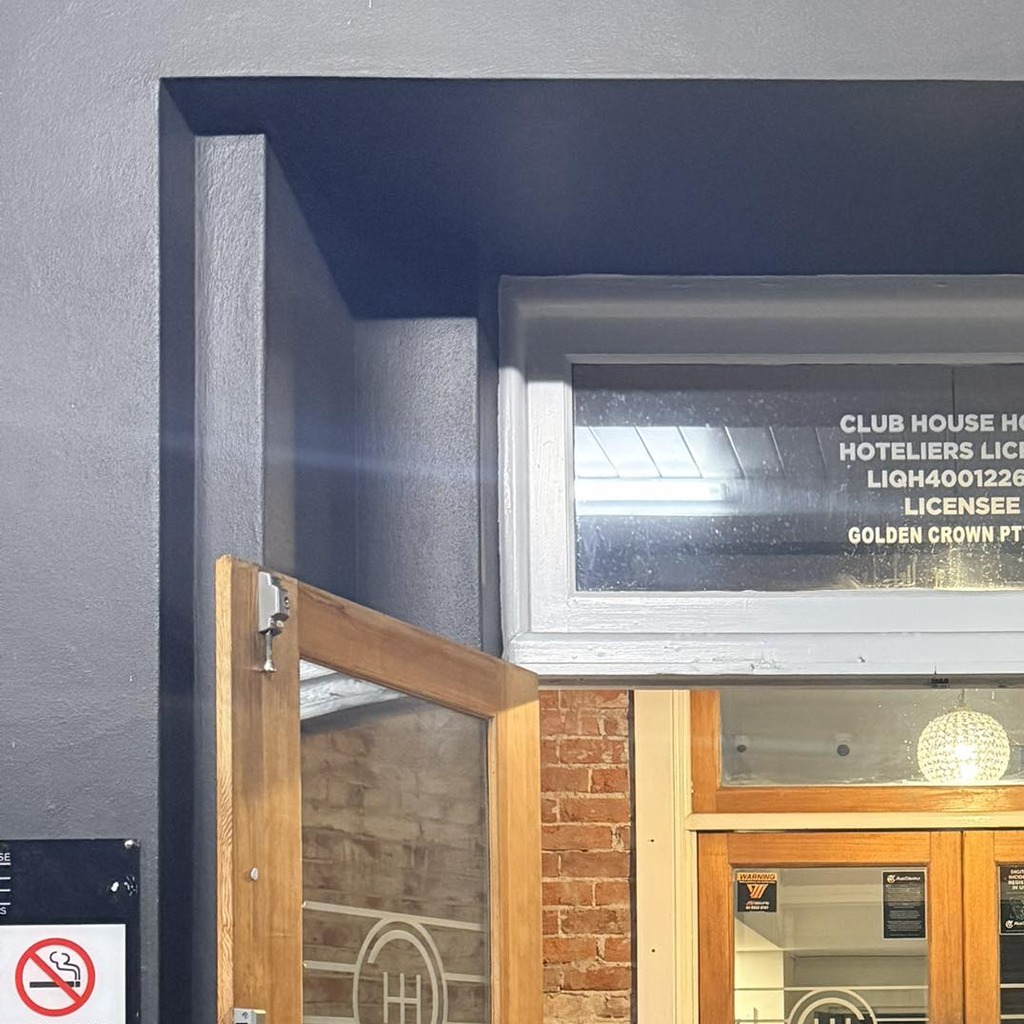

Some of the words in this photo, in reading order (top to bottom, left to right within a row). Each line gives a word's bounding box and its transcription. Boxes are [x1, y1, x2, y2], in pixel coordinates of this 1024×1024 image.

[840, 414, 904, 433] CLUB
[911, 414, 994, 432] HOUSE
[839, 442, 974, 461] HOTELIERS
[904, 497, 1020, 515] LICENSEE
[848, 526, 922, 544] GOLDEN
[928, 526, 994, 544] CROWN
